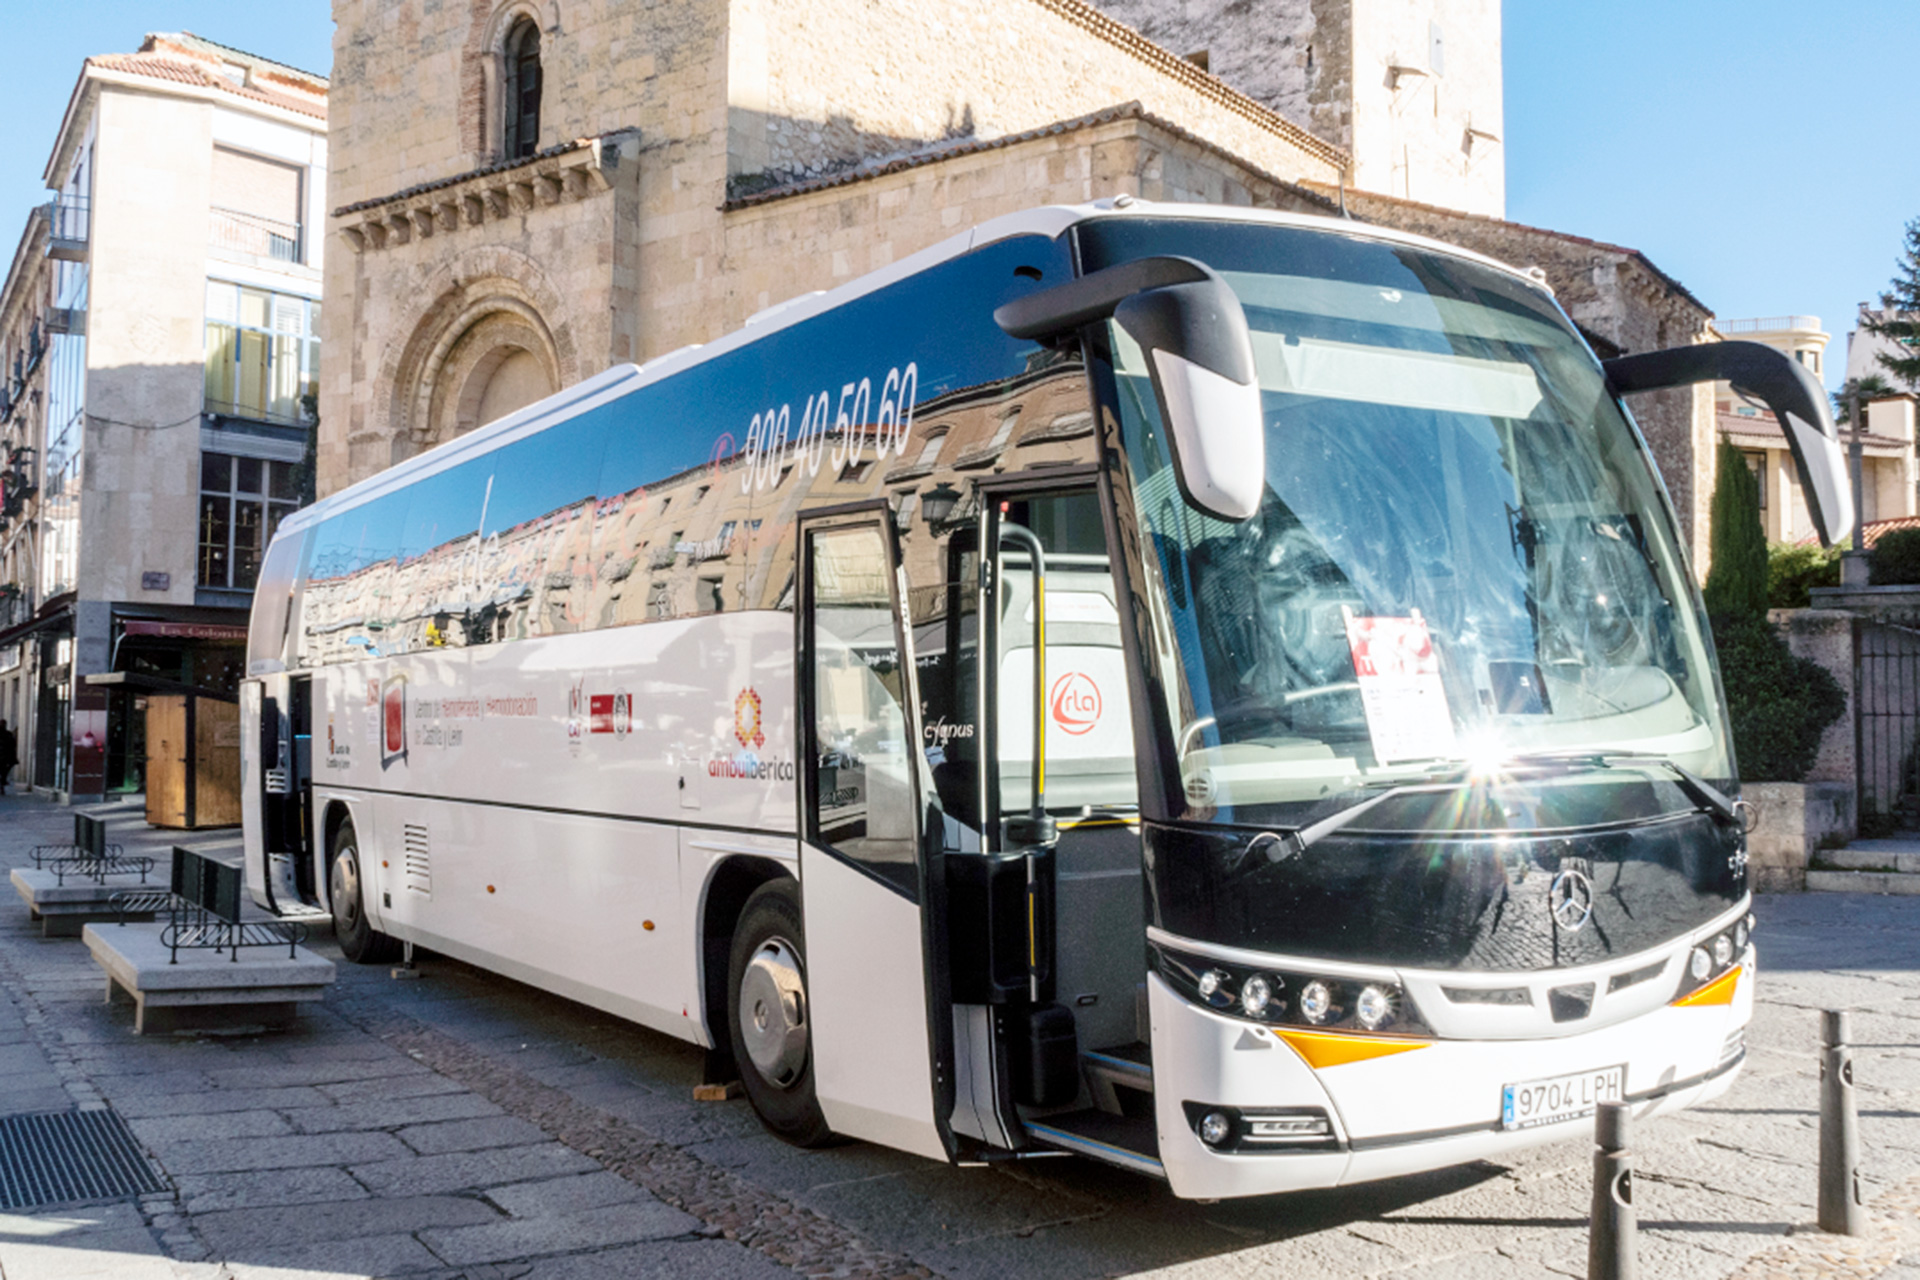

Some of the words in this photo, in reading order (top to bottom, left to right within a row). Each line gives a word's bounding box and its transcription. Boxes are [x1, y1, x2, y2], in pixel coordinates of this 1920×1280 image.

[741, 403, 790, 495] 900
[793, 390, 829, 479] 40
[831, 377, 871, 472] 50
[876, 362, 918, 460] 60
[1519, 1081, 1573, 1116] 9704
[1582, 1072, 1618, 1104] LPH
